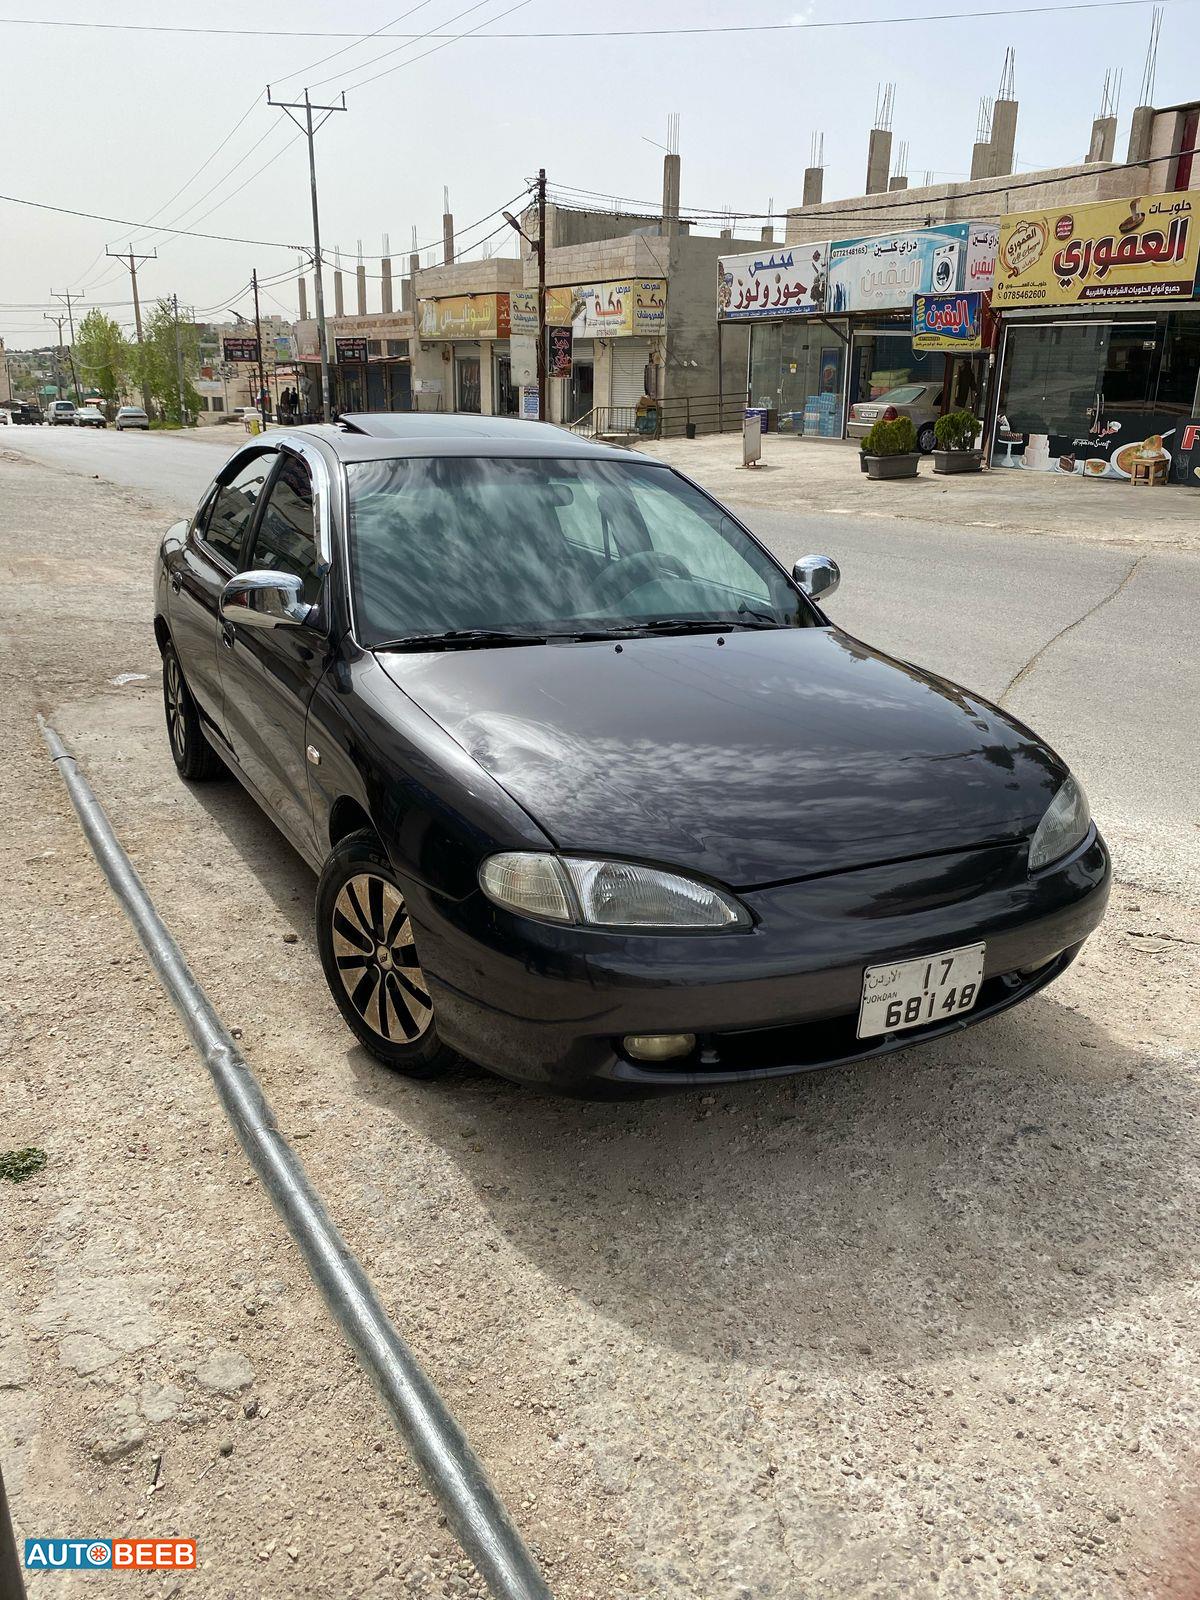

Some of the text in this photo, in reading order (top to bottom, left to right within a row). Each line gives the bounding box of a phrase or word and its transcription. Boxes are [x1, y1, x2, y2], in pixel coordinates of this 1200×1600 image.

[1149, 199, 1192, 215] حلويات
[873, 240, 917, 257] دراي كلين
[1007, 227, 1037, 257] العموري
[1053, 217, 1190, 288] العموري
[749, 251, 794, 278] محمص
[970, 256, 996, 281] اليقين
[641, 282, 661, 291] معرض
[860, 259, 923, 298] اليقين
[1085, 283, 1180, 298] جميع أنواع الحلويات الشرقية والغربية
[594, 291, 623, 316] مكة
[636, 293, 665, 308] مكة
[734, 273, 807, 310] جوز ولوز
[1003, 290, 1047, 300] 0785462600
[513, 301, 537, 313] مكة
[636, 310, 665, 320] للمفروشات
[926, 300, 969, 333] اليقين
[923, 957, 955, 990] 17
[866, 992, 898, 1004] JORDAN
[885, 983, 976, 1028] 68148
